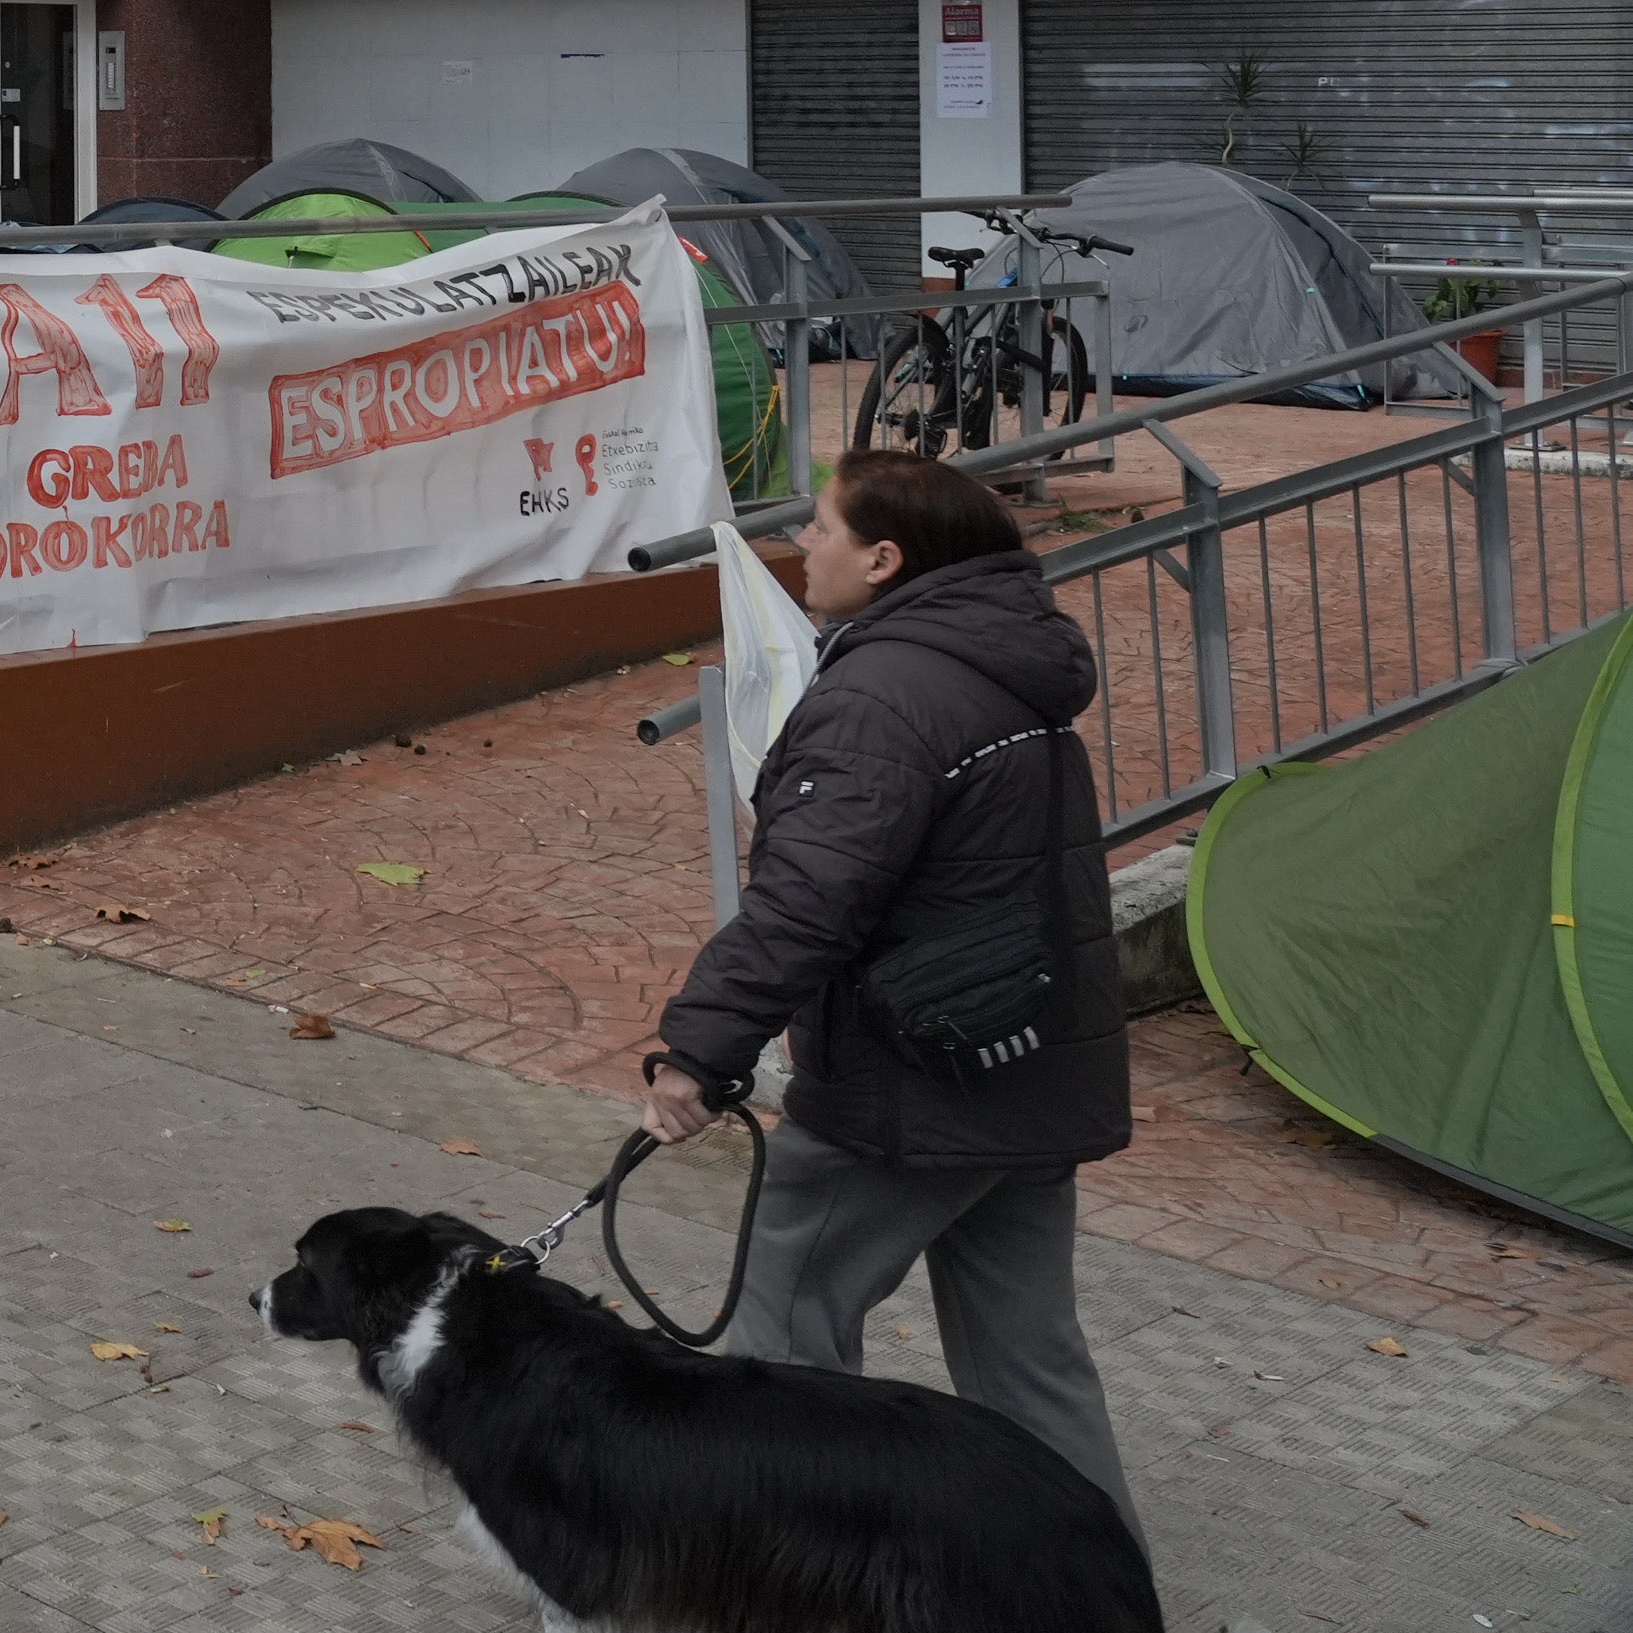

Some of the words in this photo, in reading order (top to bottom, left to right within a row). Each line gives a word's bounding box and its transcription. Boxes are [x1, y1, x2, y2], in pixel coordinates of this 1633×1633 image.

[246, 244, 641, 325] ESPEKULATZAILEAK
[279, 299, 632, 460] ESPROPIATU!
[26, 433, 189, 509] GREBA
[520, 487, 569, 517] EHKS
